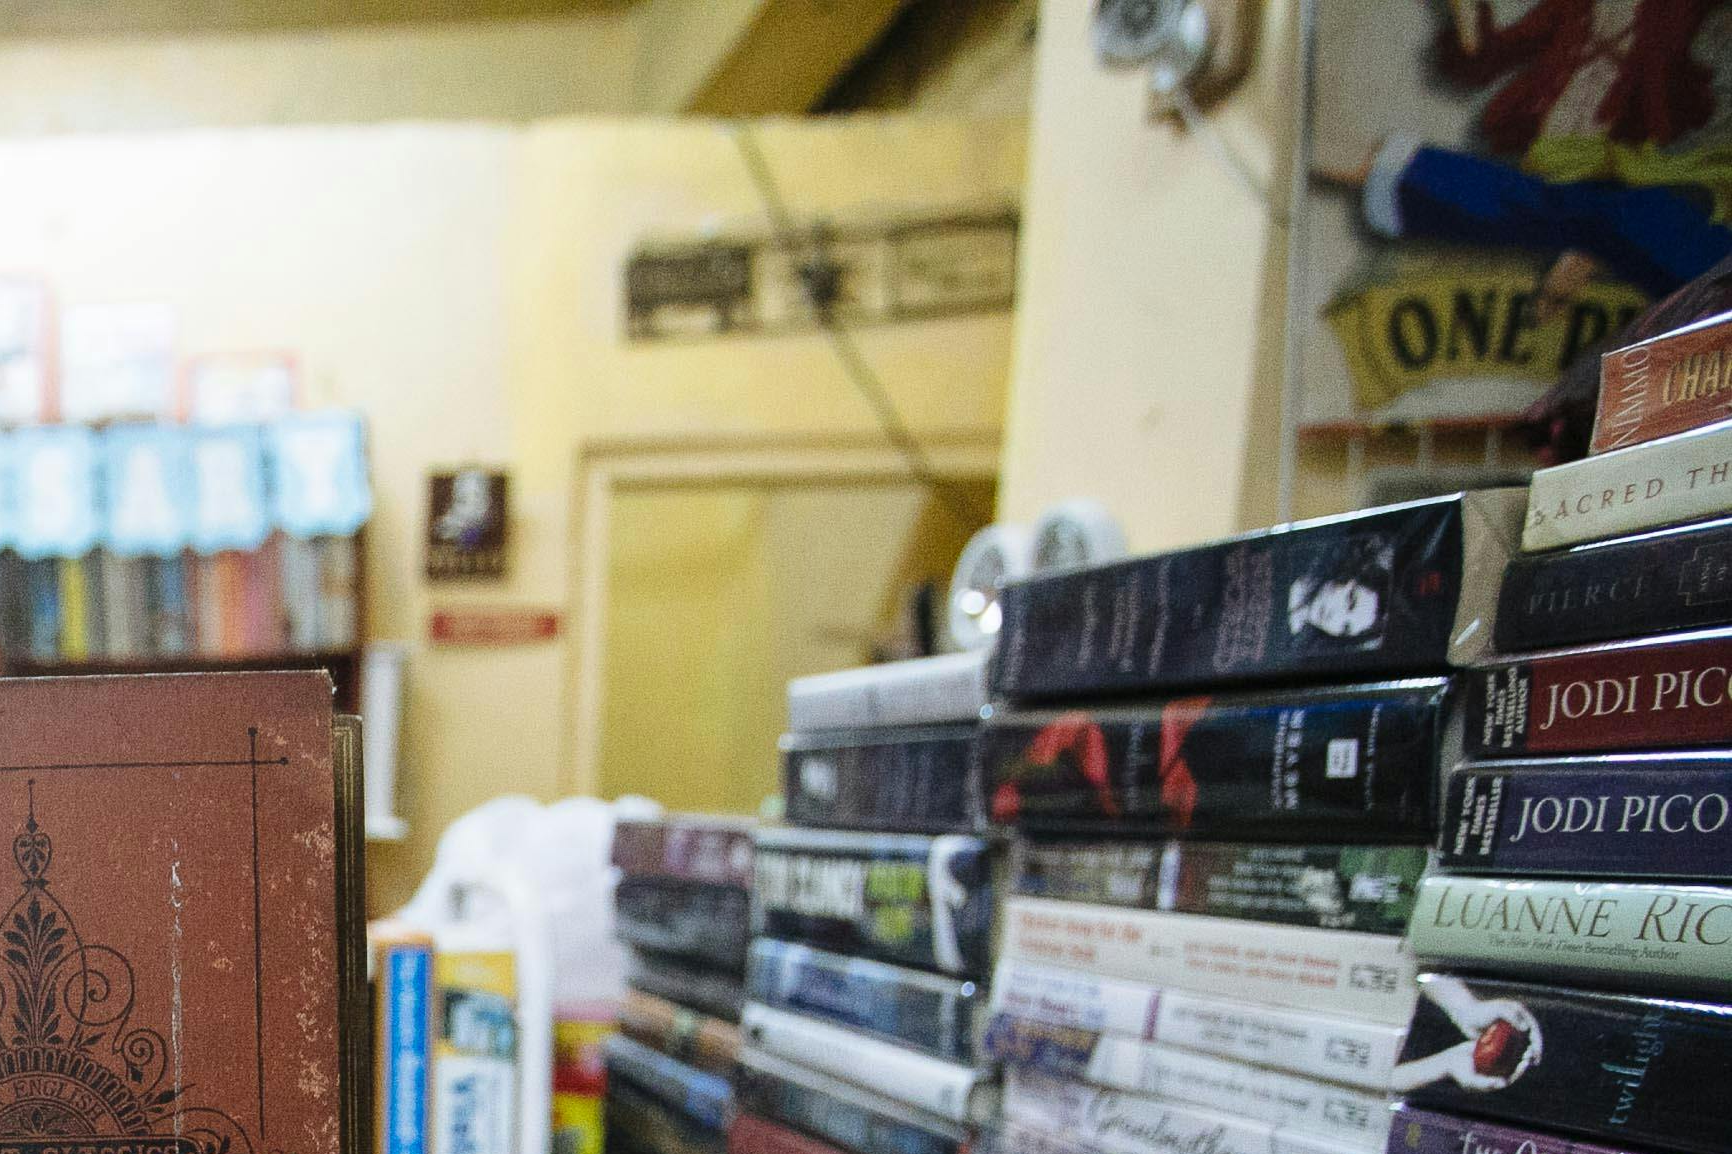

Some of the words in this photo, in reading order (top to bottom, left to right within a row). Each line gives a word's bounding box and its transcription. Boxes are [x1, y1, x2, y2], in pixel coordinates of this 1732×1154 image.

[1385, 288, 1546, 370] ONE
[1662, 347, 1732, 405] CHA
[1539, 675, 1639, 730] JODI
[1651, 666, 1732, 712] PIC
[1509, 795, 1613, 843] JODI
[1619, 792, 1730, 834] PICO
[1433, 885, 1618, 939] LUANNE
[1639, 946, 1680, 961] Author
[1600, 1008, 1666, 1126] twilight
[13, 1078, 104, 1121] ENGLISH
